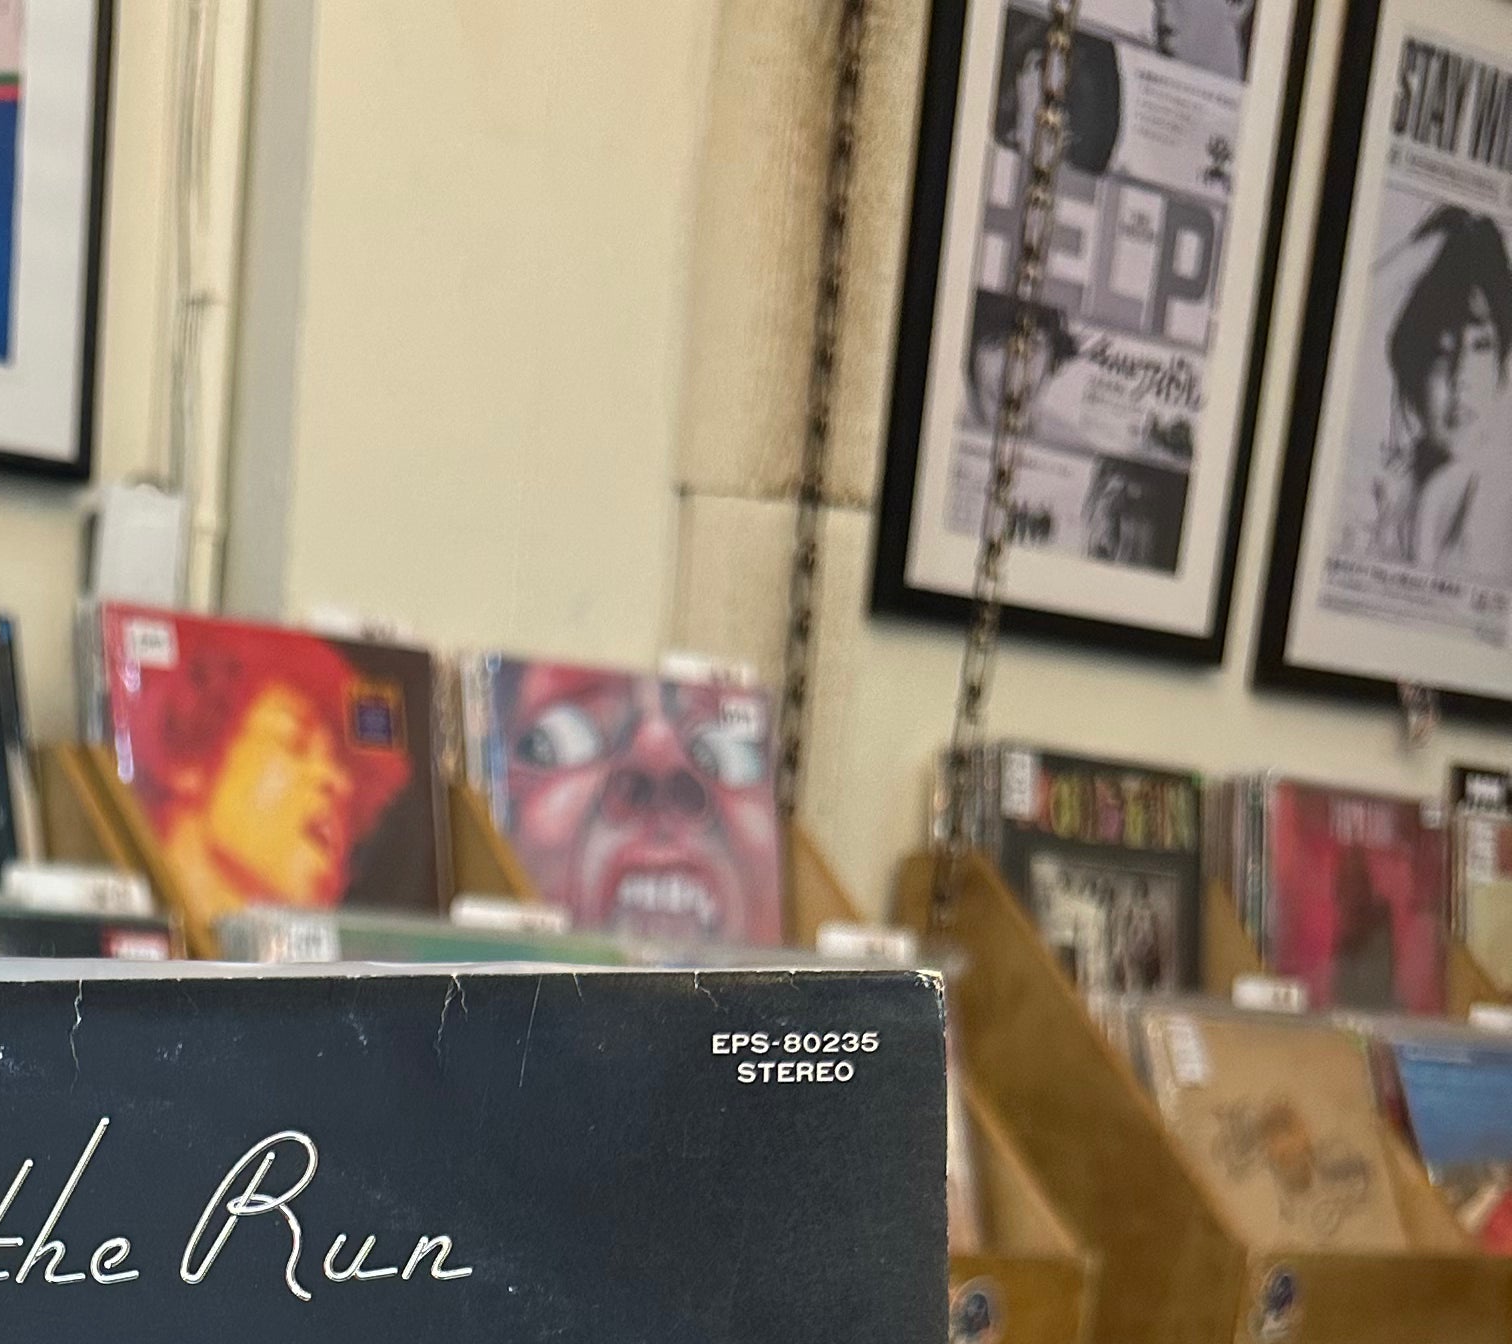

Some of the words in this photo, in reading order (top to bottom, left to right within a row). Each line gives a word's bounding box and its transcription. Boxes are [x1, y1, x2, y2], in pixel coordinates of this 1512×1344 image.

[712, 1031, 880, 1054] EPS-80235
[737, 1061, 854, 1083] STEREO
[180, 1130, 472, 1301] Run
